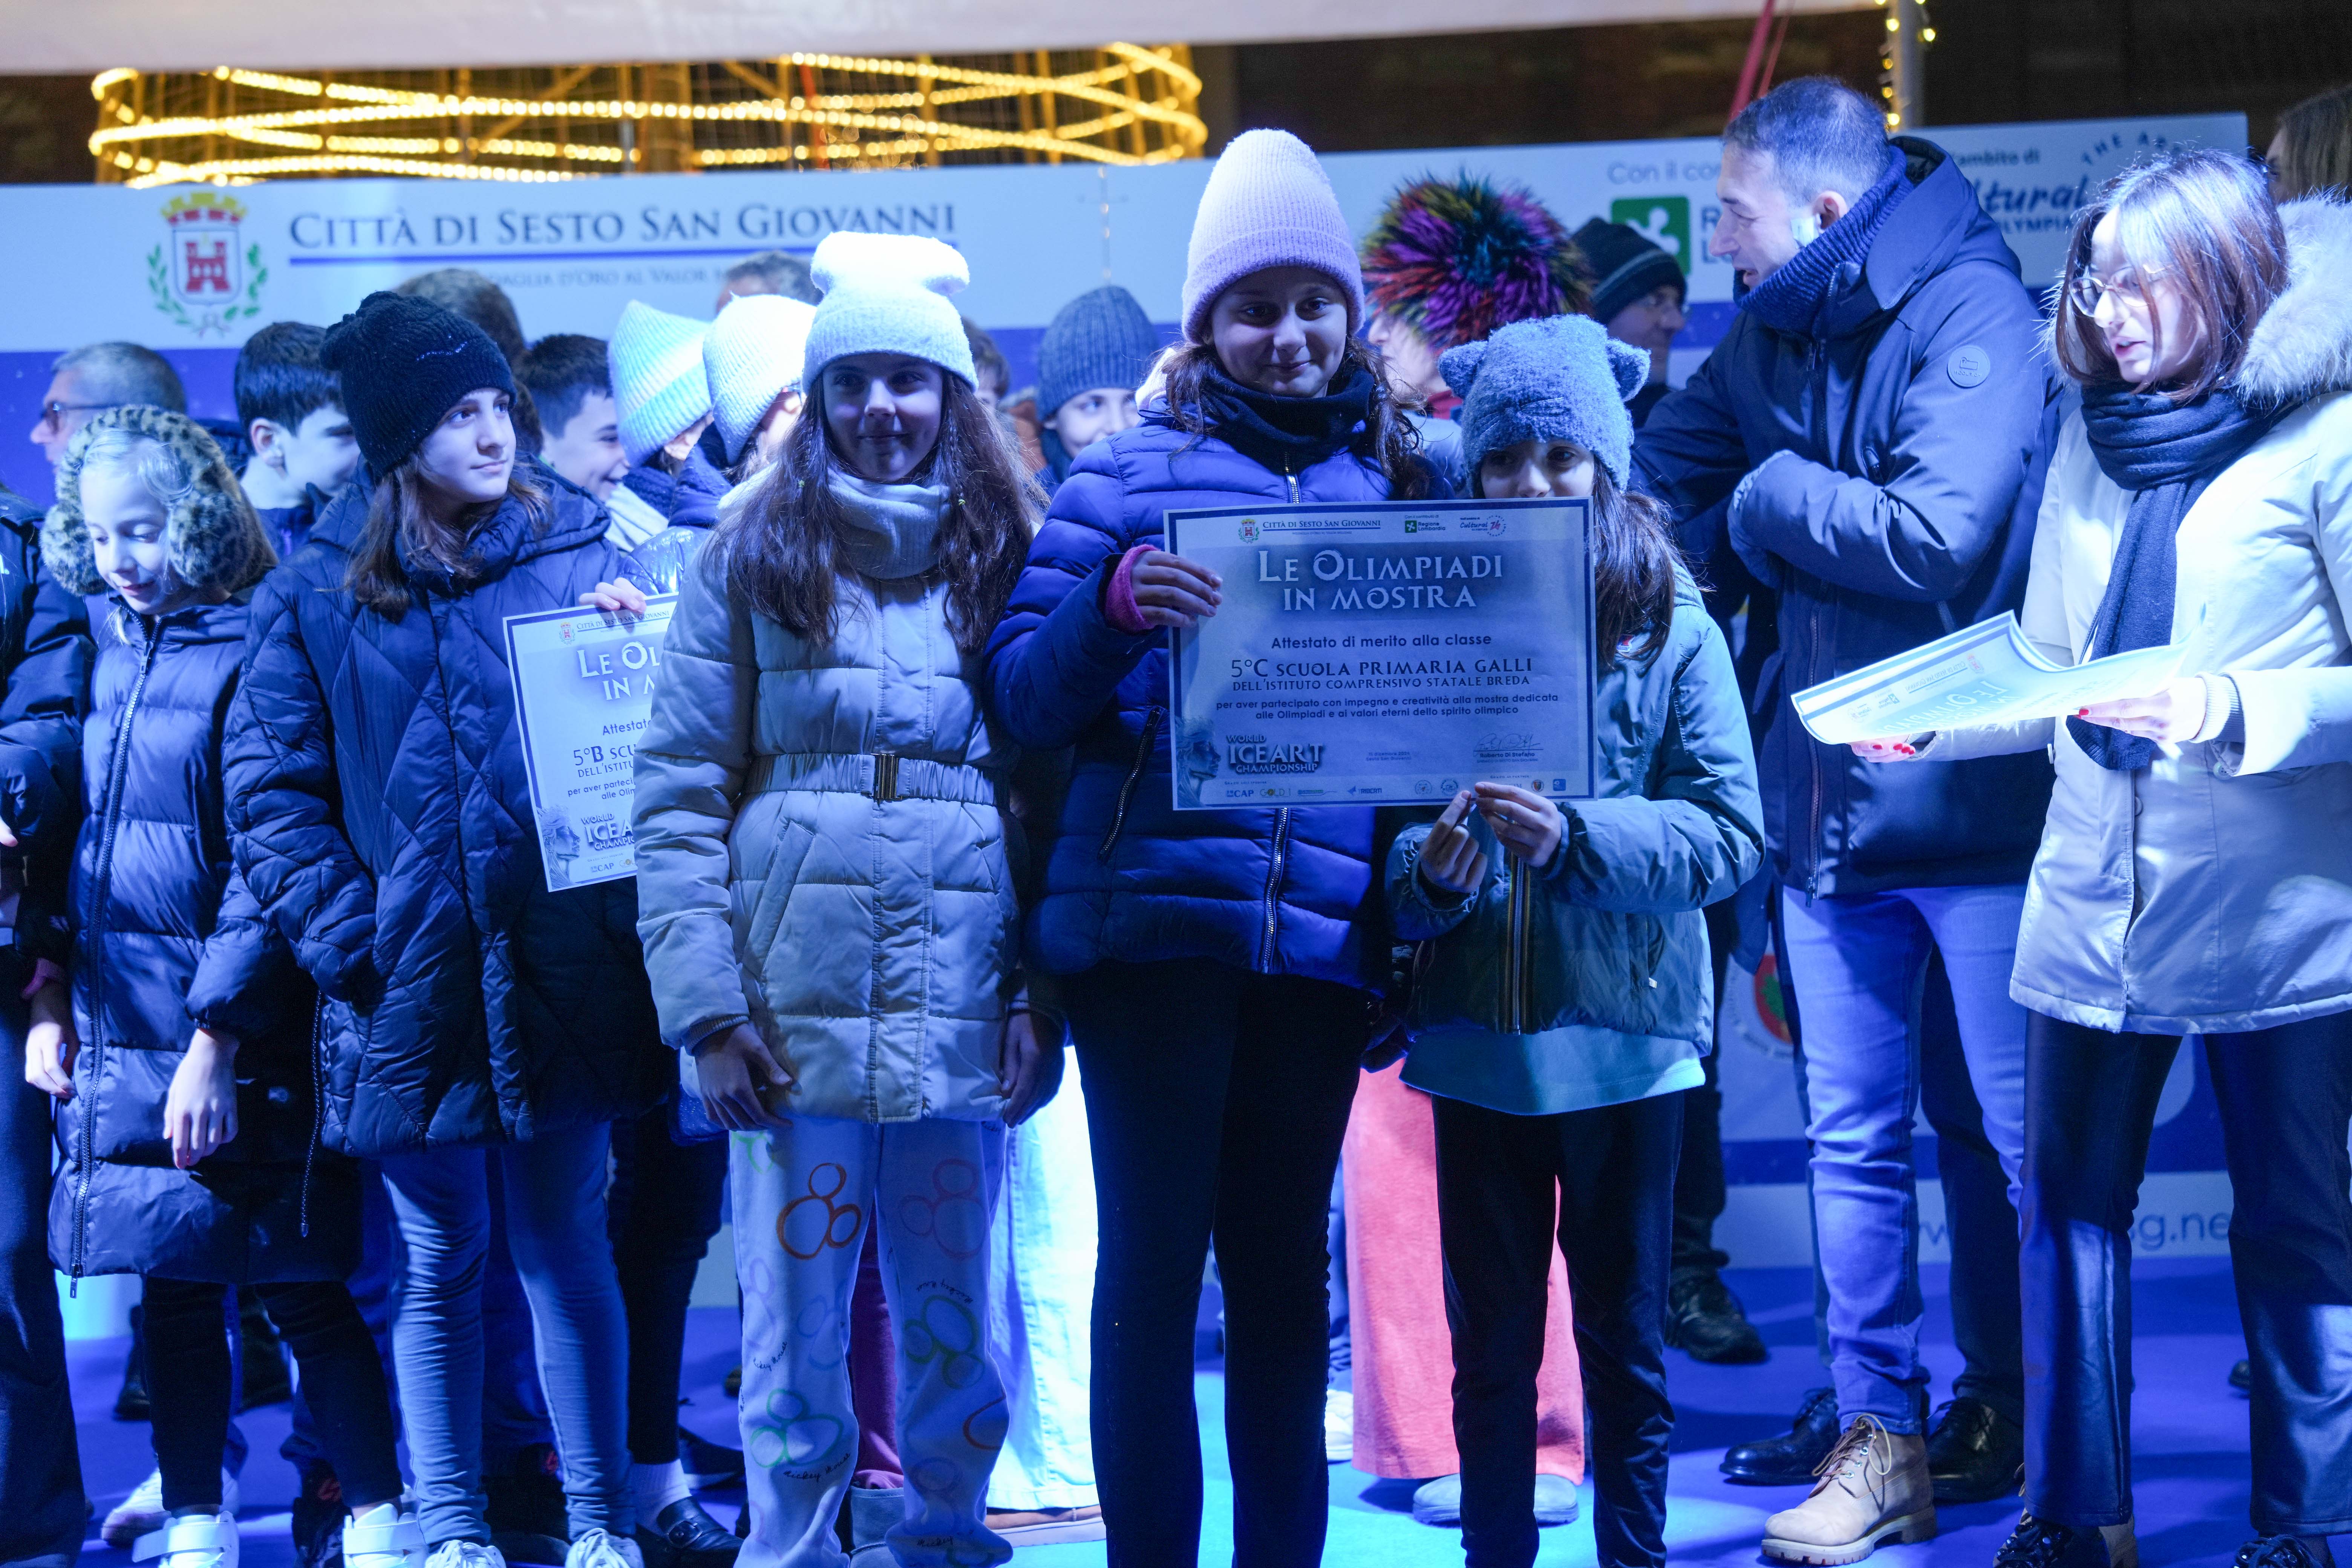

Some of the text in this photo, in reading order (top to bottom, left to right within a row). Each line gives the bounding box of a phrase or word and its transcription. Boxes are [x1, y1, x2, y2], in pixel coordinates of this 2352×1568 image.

[1607, 162, 1660, 184] Con
[1974, 174, 2089, 213] tural
[290, 202, 955, 248] CITTÀ DI SESTO SAN GIOVANNI
[1258, 550, 1502, 582] LE OLIMPIADI
[1283, 585, 1477, 611] IN MOSTRA
[577, 621, 594, 629] CITTÀ
[638, 611, 669, 621] GIOVANNI
[1271, 634, 1491, 649] Attestato di merito alla classe
[576, 649, 614, 678] LE
[1231, 658, 1532, 678] 5°C SCUOLA PRIMARIA GALLI
[602, 677, 632, 700] IN
[1233, 676, 1530, 691] DELL'ISTITUTO COMPRENSIVO STATALE BREDA
[1217, 702, 1233, 710] per
[1262, 699, 1319, 709] partecipato
[1345, 698, 1389, 707] impegno
[1402, 695, 1449, 705] creatività
[1453, 695, 1471, 704] alla
[1513, 694, 1558, 702] dedicata
[1277, 710, 1325, 720] Olimpiadi
[1381, 708, 1409, 716] eterni
[1413, 707, 1438, 716] dello
[1441, 706, 1470, 716] spirito
[1475, 706, 1518, 715] olimpico
[574, 744, 636, 766] 5°B SCU
[578, 761, 634, 777] DELL'ISTITU
[1236, 763, 1318, 773] CHAMPIONSHIP
[568, 789, 580, 797] per
[604, 778, 635, 790] parteci
[581, 813, 614, 825] WORLD
[594, 836, 635, 850] CHAMPI
[597, 863, 614, 871] CAP
